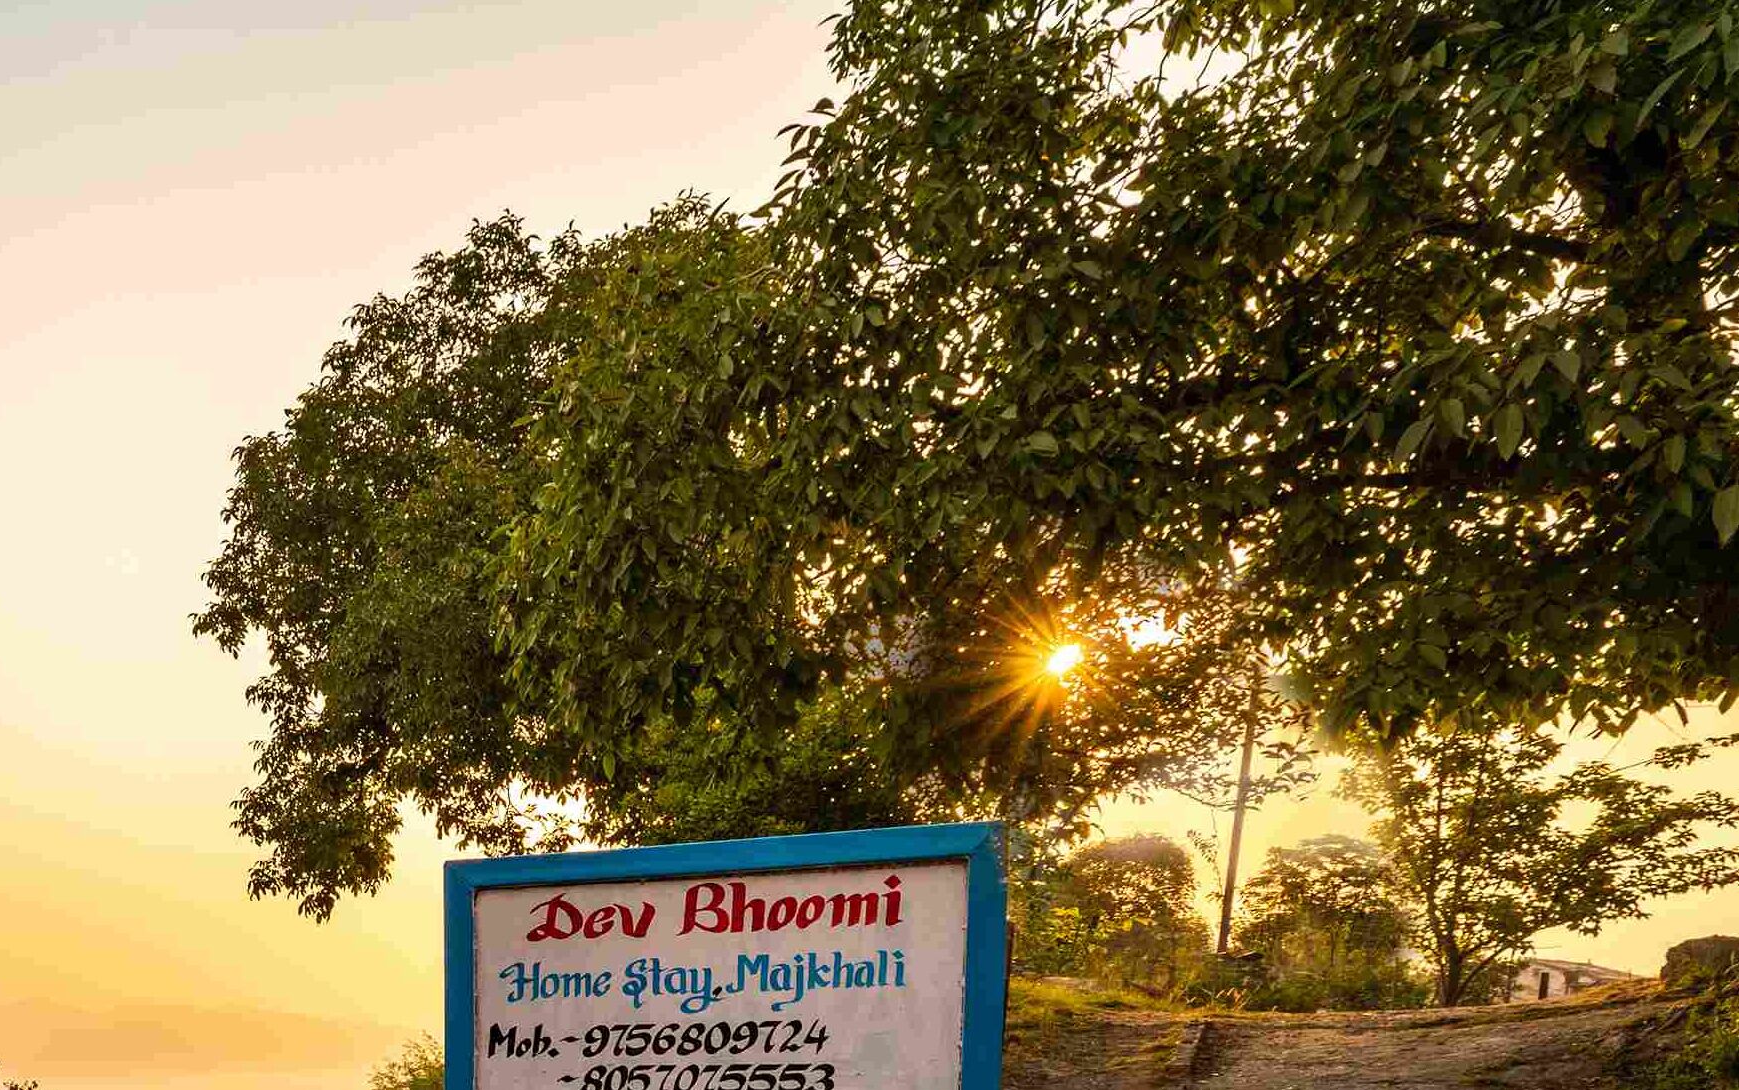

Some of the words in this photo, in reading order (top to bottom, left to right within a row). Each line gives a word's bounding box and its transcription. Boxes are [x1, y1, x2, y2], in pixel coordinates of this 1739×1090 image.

[526, 892, 656, 942] Dev
[676, 874, 904, 937] Bhoomi
[499, 961, 612, 1003] Home
[725, 949, 906, 1012] Majkhali
